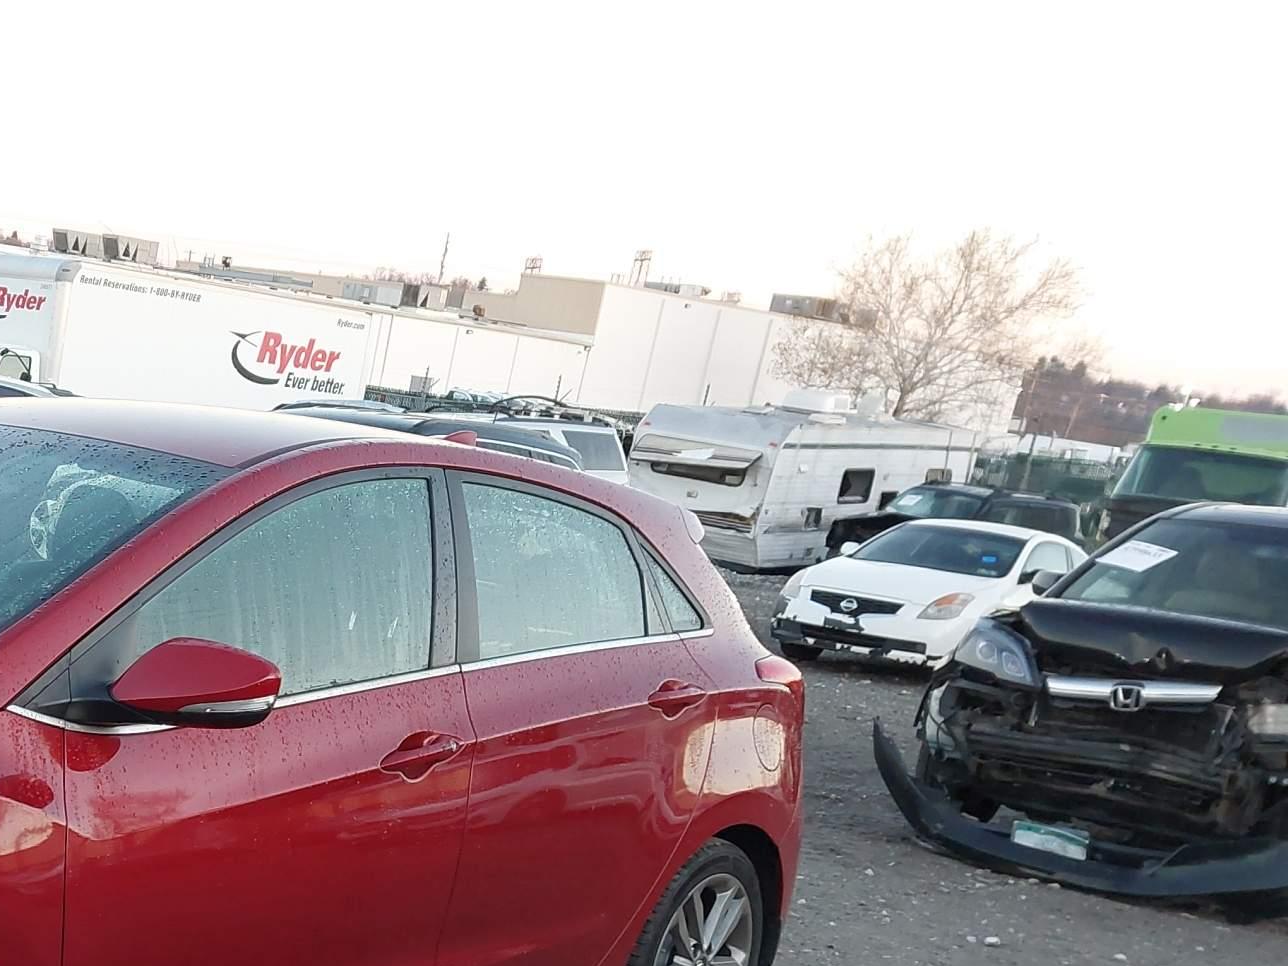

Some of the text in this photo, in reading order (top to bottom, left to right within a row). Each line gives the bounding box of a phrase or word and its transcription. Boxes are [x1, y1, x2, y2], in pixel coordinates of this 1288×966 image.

[79, 274, 103, 286] Rental
[103, 278, 148, 294] Reservations:
[336, 318, 366, 330] Ryder.com
[256, 331, 342, 374] Ryder
[284, 371, 346, 395] Ever better.
